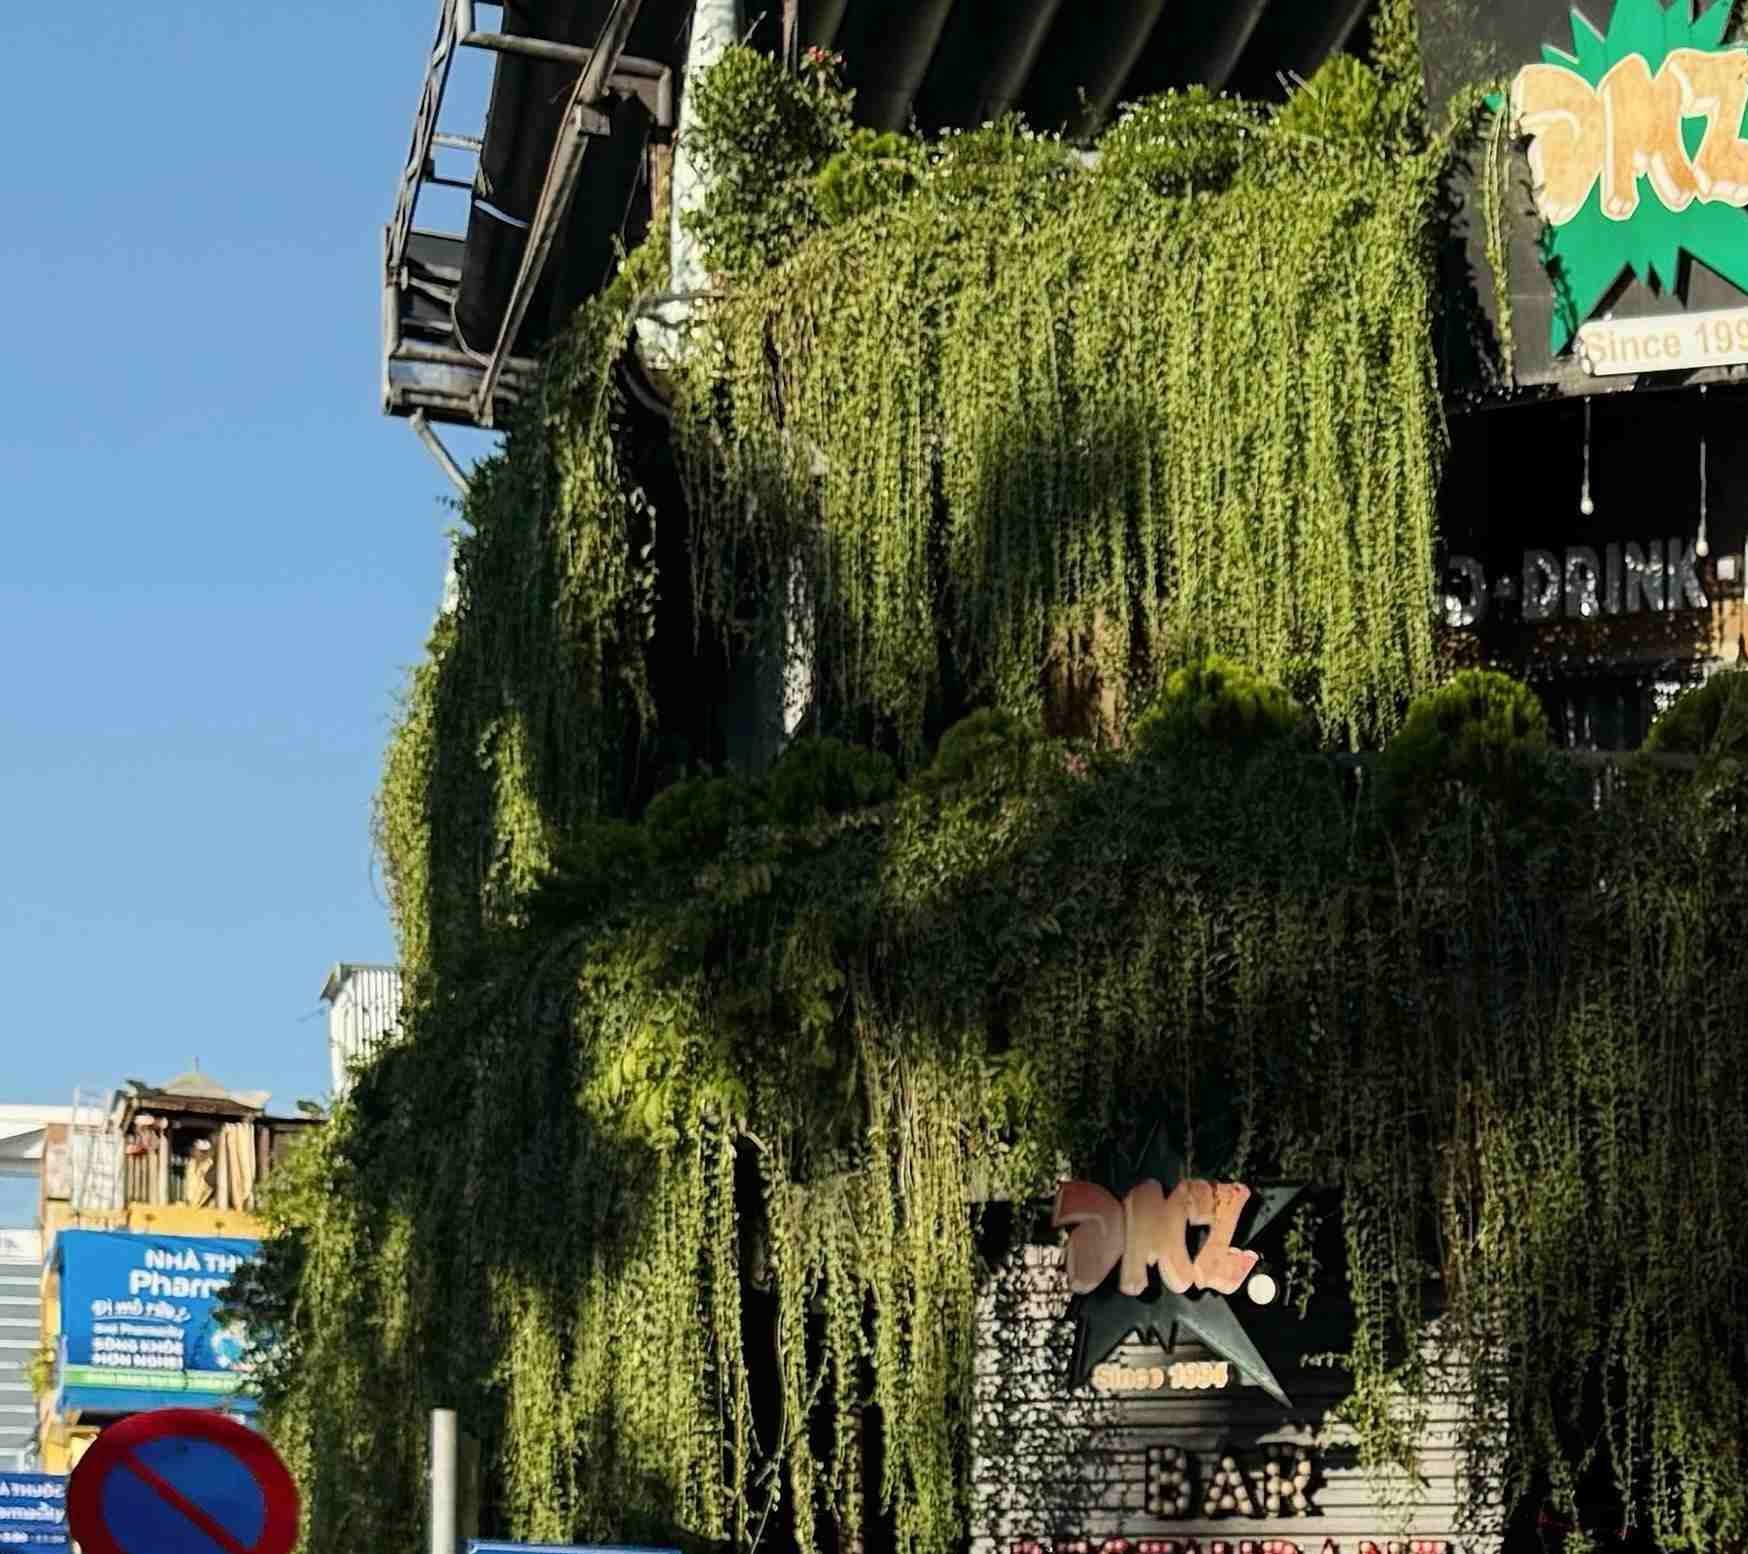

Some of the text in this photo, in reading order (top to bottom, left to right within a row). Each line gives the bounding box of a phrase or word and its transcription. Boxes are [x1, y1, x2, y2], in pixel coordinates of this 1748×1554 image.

[1587, 326, 1682, 361] Since
[1522, 535, 1708, 619] DRINK
[144, 1248, 201, 1272] NHÀ
[1052, 1179, 1259, 1296] DMZ
[1091, 1362, 1166, 1392] Since
[1145, 1443, 1323, 1519] BAR
